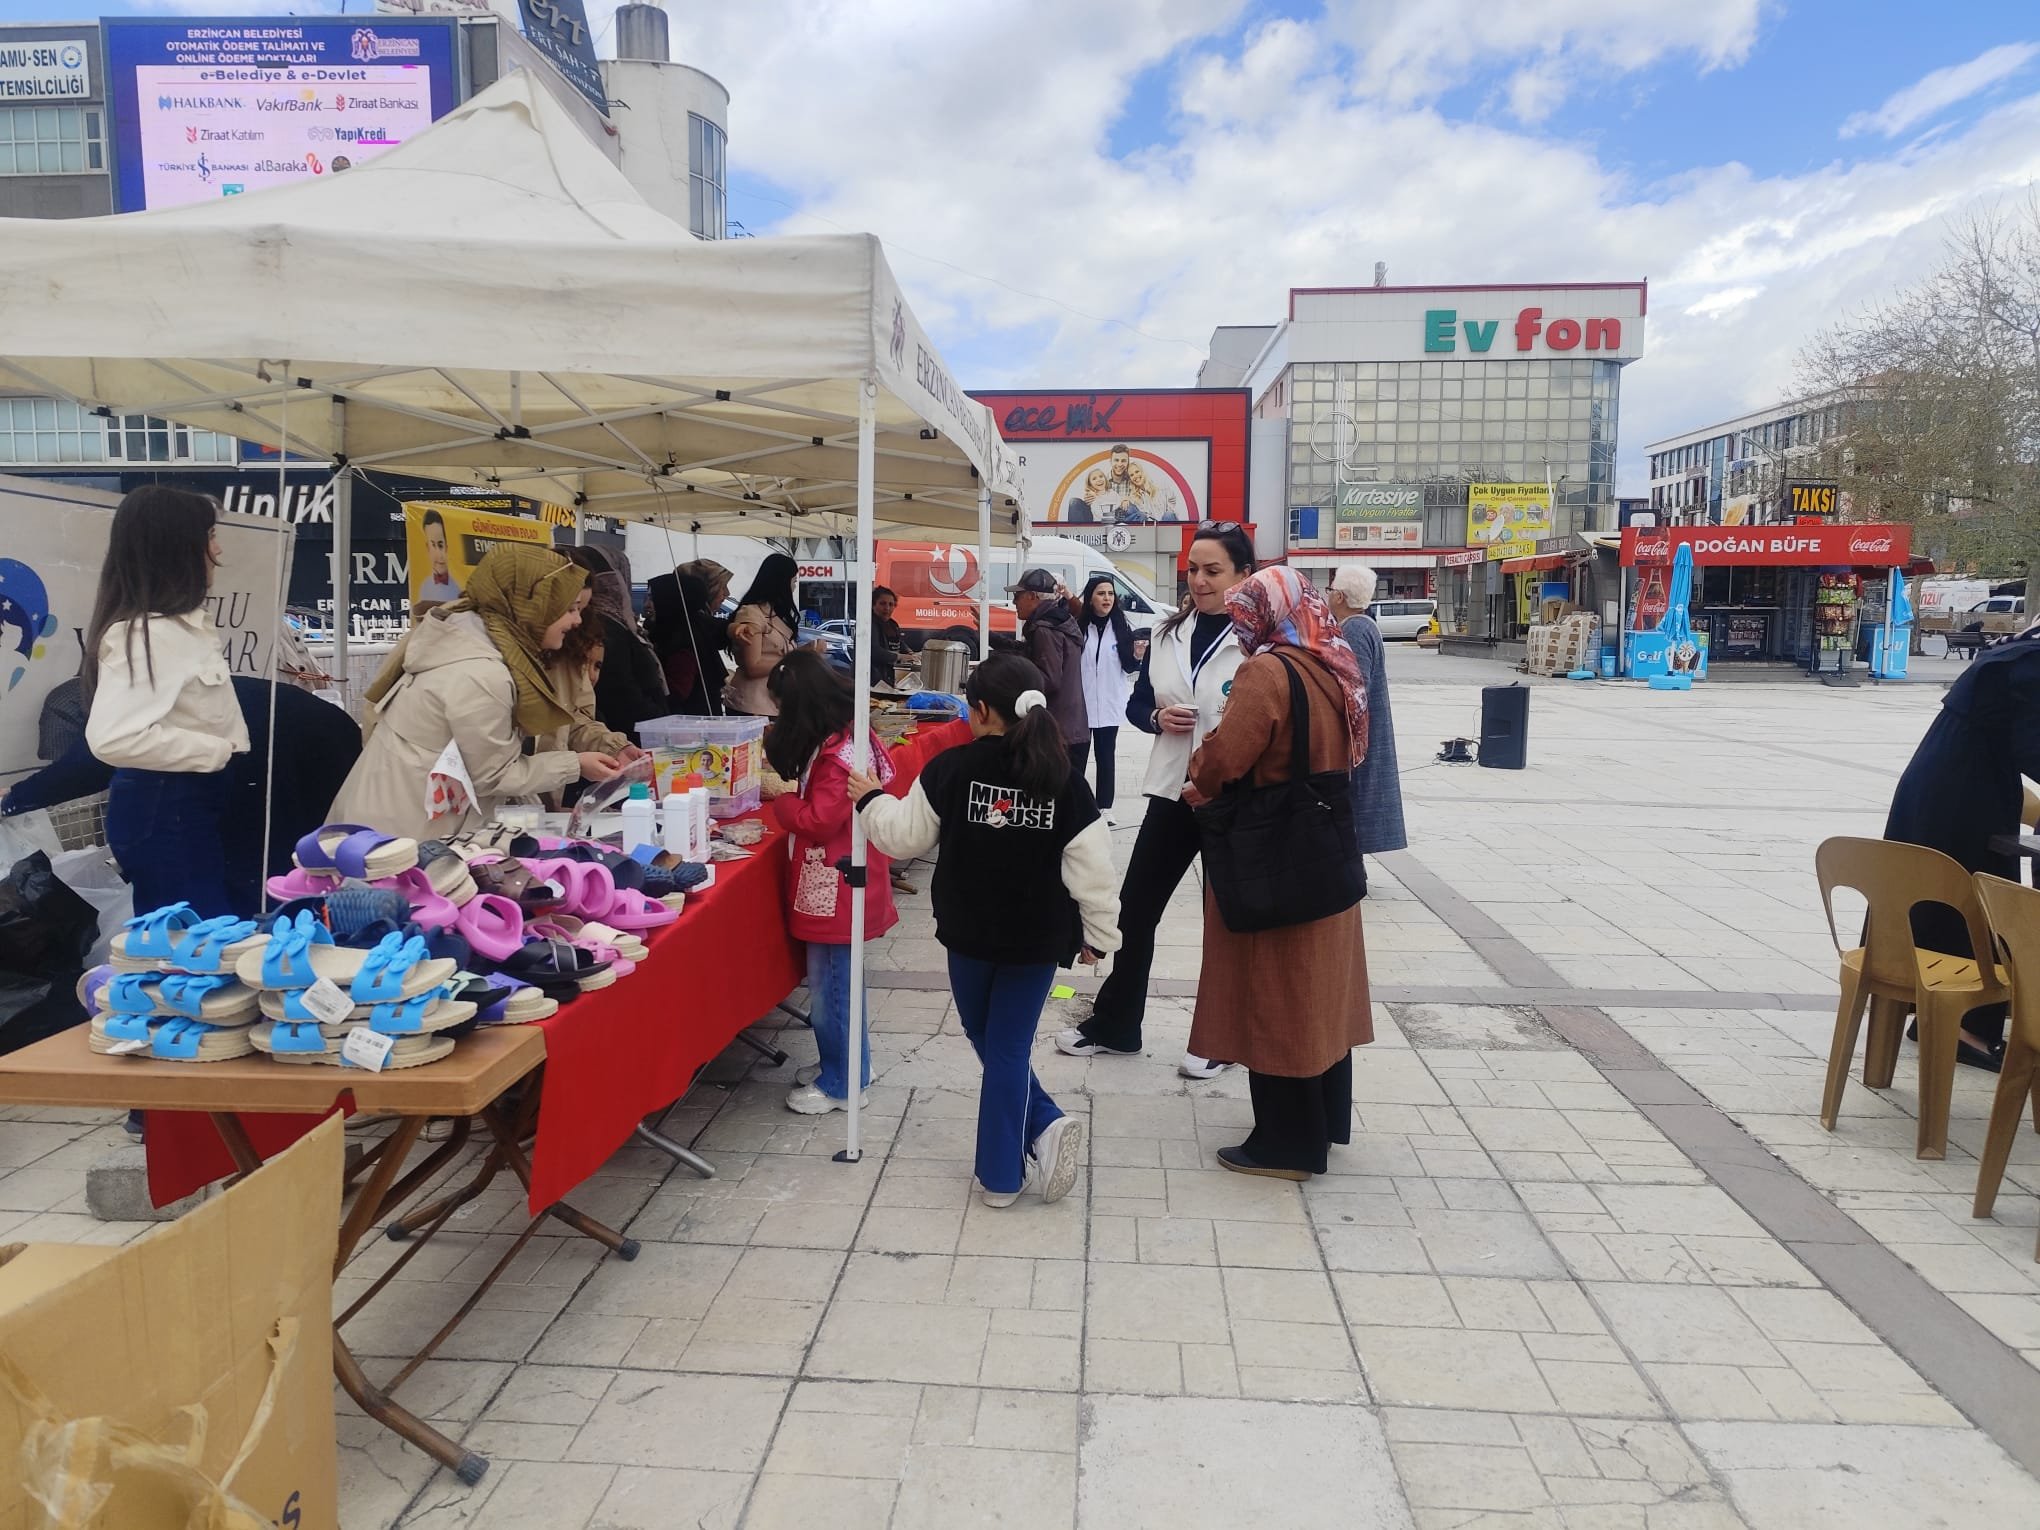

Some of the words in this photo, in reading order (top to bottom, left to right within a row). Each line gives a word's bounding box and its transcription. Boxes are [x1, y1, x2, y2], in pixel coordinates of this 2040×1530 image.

[187, 27, 241, 38] ERZİNCAN
[243, 27, 303, 38] BELEDİYESİ
[166, 41, 220, 51] OTOMATİK
[222, 41, 260, 51] ÖDEME
[261, 41, 309, 51] TALİMATI
[311, 41, 325, 51] VE
[0, 49, 57, 67] AMU-SEN
[218, 53, 255, 63] ÖDEME
[200, 69, 282, 82] e-Belediye
[286, 70, 297, 80] &
[301, 69, 366, 81] e-Devlet
[0, 74, 84, 96] TEMSİLCİLİĞİ
[173, 97, 243, 110] HALKBANK
[348, 97, 378, 109] Ziraat
[379, 97, 419, 109] Bankası
[200, 129, 230, 141] Ziraat
[231, 129, 264, 141] Katılım
[254, 159, 308, 172] alBaraka
[223, 485, 334, 523] linlik
[1342, 488, 1419, 507] Kırtasiye
[474, 539, 496, 552] EYME
[1694, 536, 1765, 553] DOĞAN
[1770, 536, 1822, 553] BÜFE
[798, 566, 833, 577] OSCH
[968, 801, 1054, 830] MUSE
